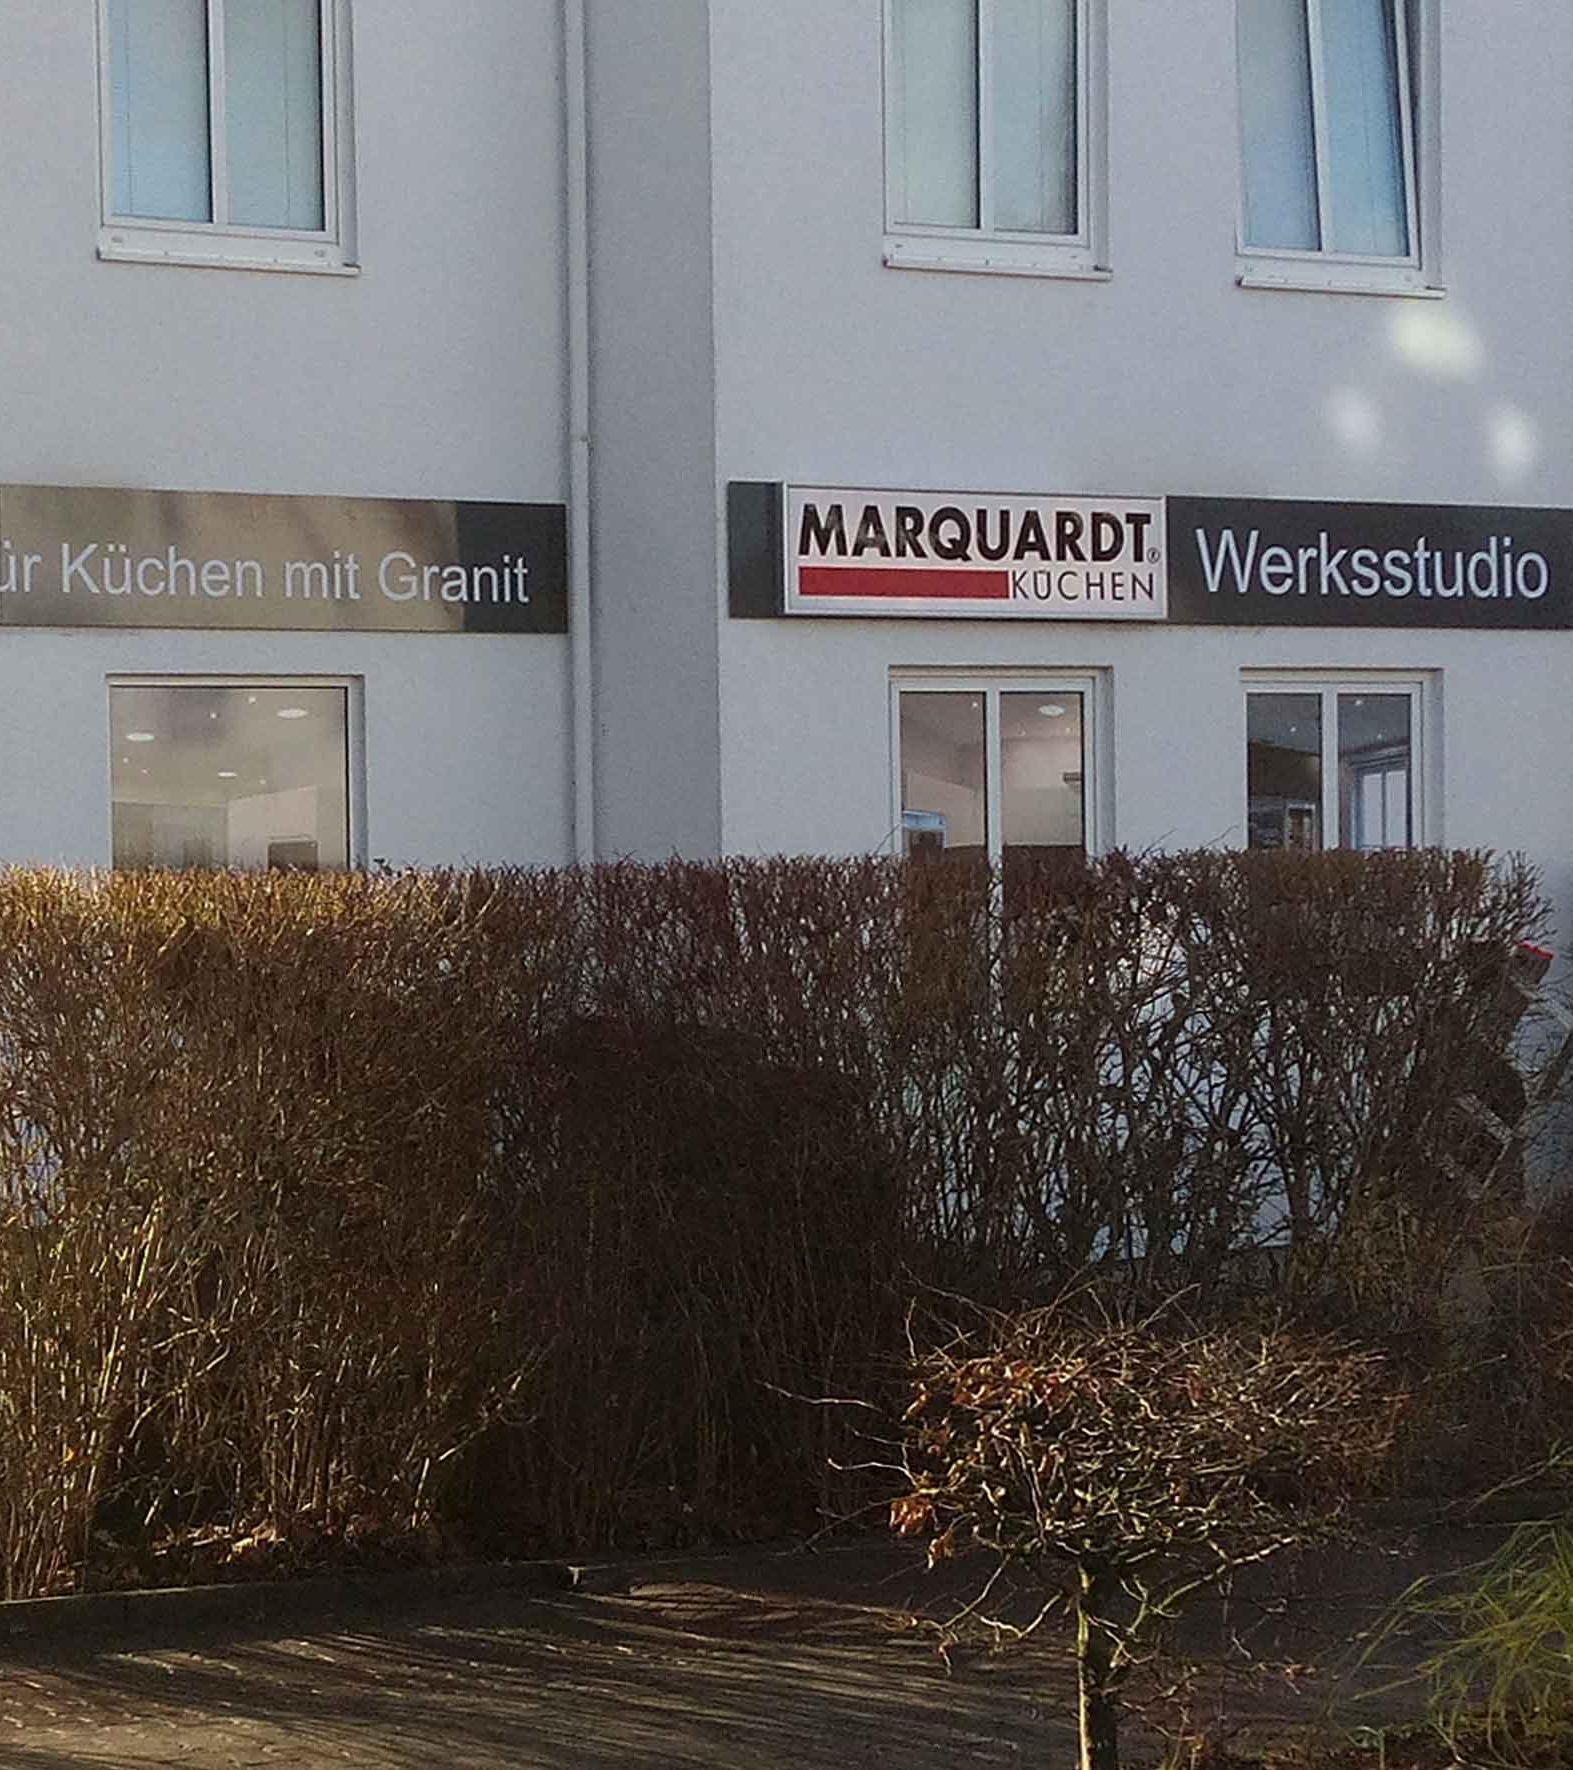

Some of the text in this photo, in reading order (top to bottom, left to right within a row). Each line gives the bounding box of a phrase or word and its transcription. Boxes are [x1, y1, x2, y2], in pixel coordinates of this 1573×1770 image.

[798, 503, 1152, 564] MARQUARDT
[61, 543, 263, 598] Küchen
[284, 550, 360, 600] mit
[378, 550, 530, 602] Granit
[1012, 569, 1155, 601] KÜCHEN
[1195, 529, 1550, 599] Werksstudio
